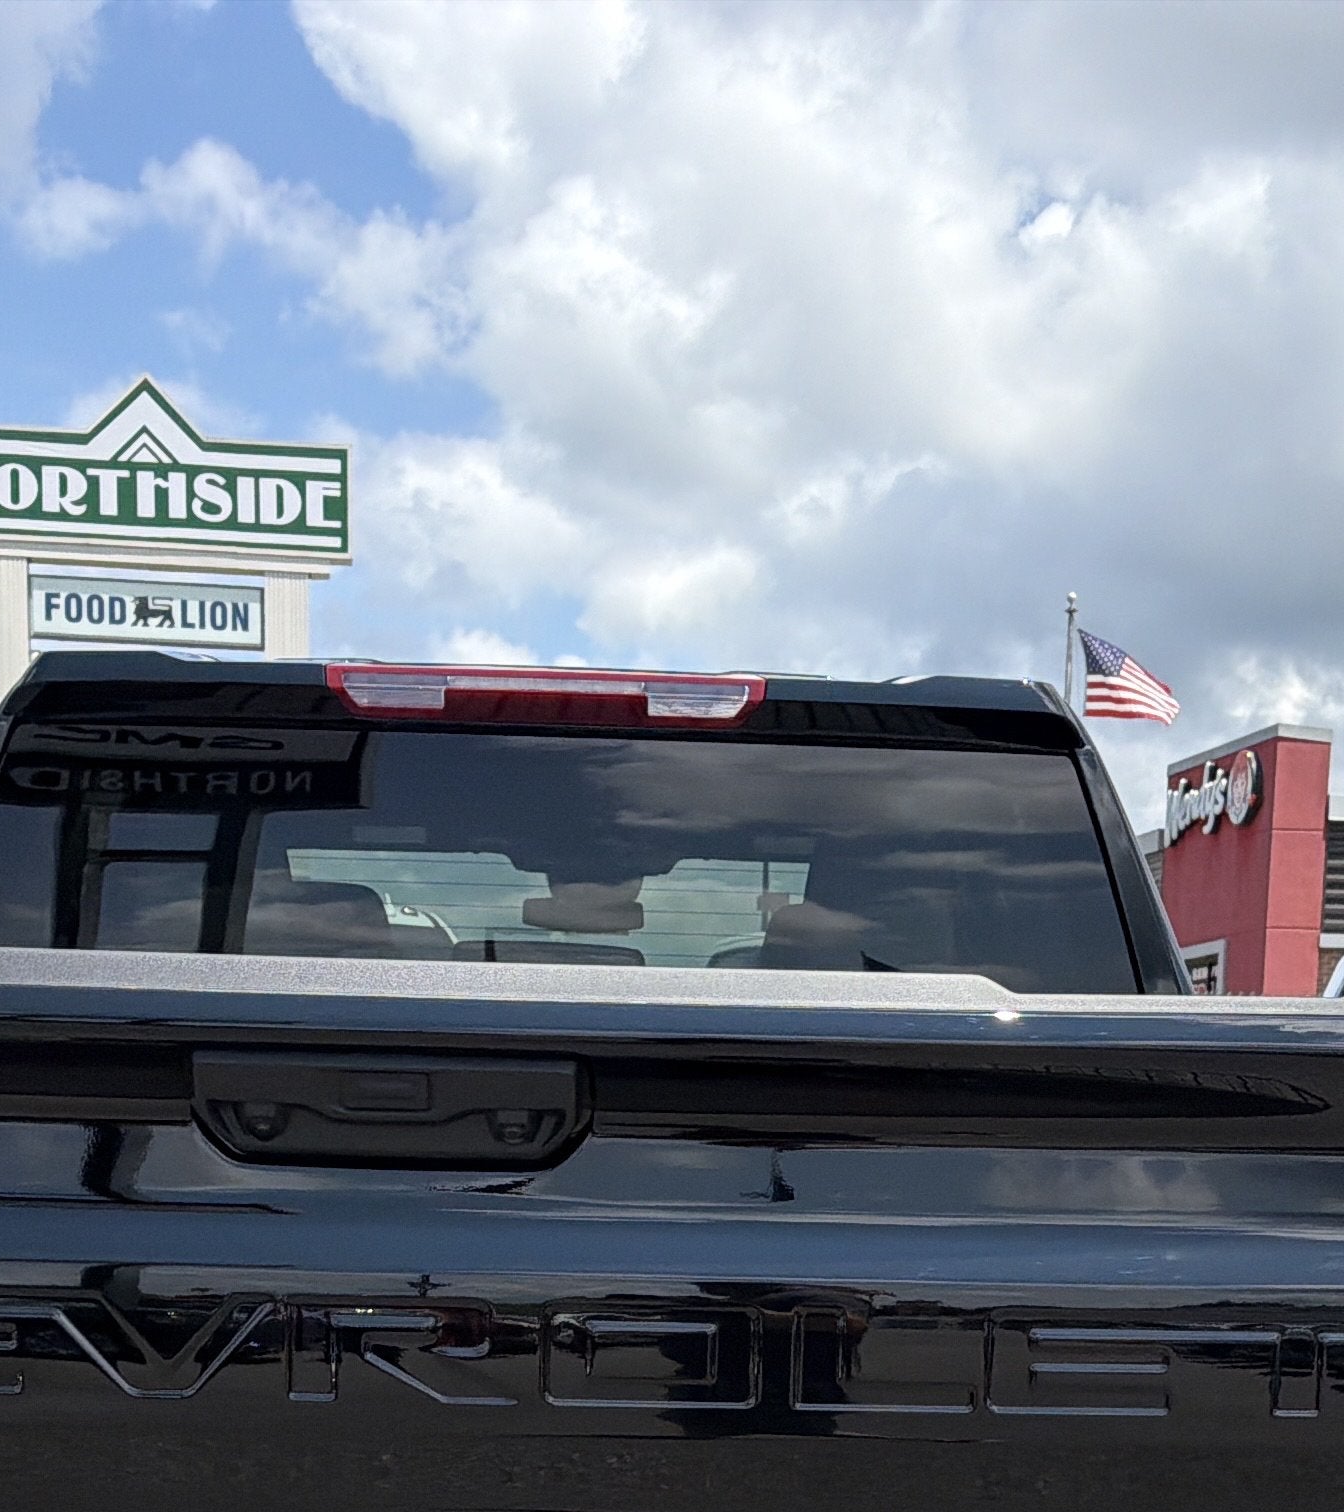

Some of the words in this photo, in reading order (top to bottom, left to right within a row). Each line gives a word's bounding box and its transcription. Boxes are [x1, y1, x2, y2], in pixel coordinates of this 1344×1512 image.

[44, 591, 127, 625] FOOD
[180, 600, 250, 632] LION
[1163, 760, 1229, 849] Wendy's
